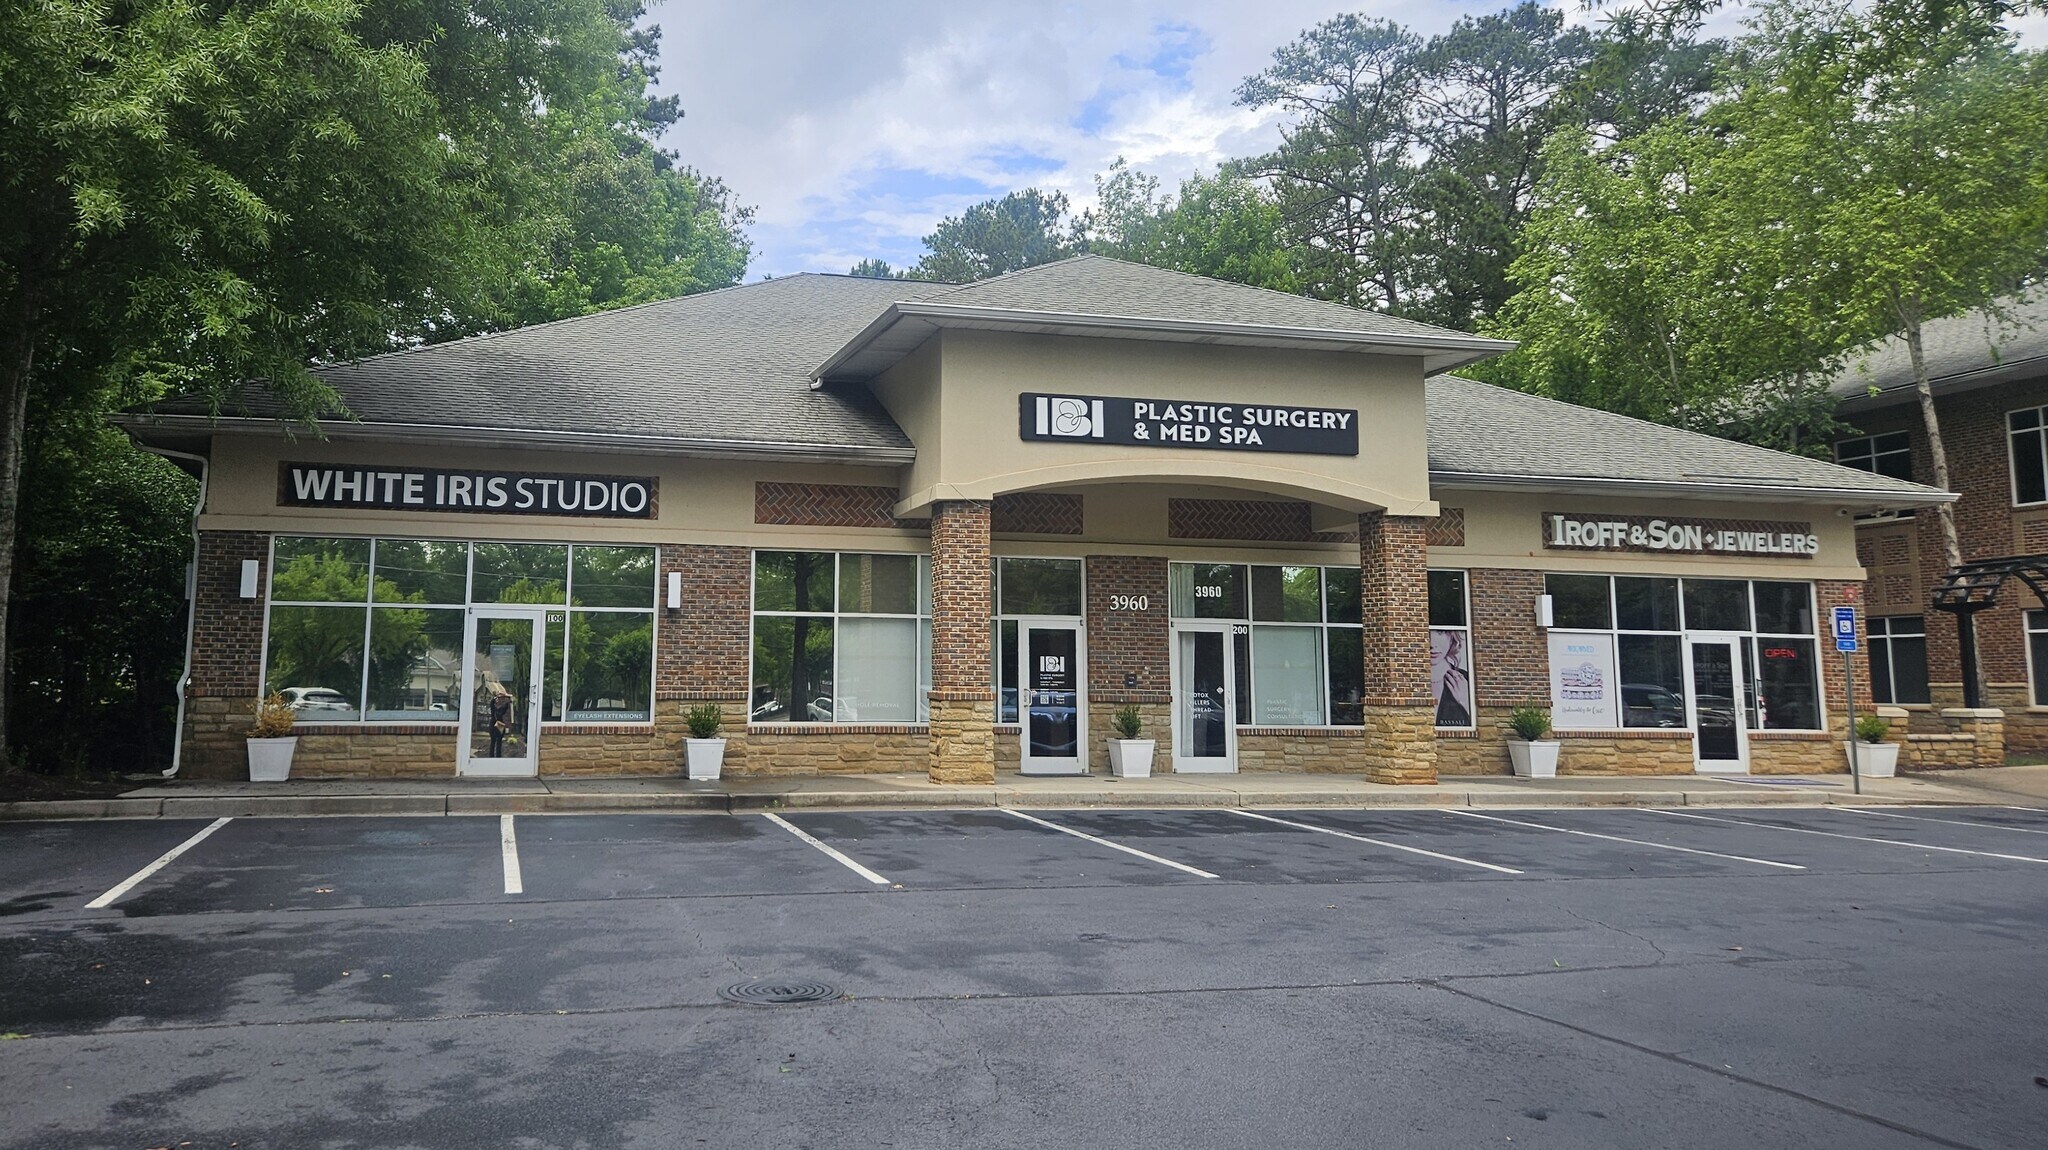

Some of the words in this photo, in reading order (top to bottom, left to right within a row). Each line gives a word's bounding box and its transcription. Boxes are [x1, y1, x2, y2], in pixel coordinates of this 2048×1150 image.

[1134, 402, 1233, 424] PLASTIC
[1242, 407, 1352, 430] SURGERY
[1133, 422, 1151, 440] &
[1160, 423, 1212, 443] MED
[1218, 426, 1263, 445] SPA
[292, 468, 425, 504] WHITE
[435, 474, 507, 508] IRIS
[514, 478, 648, 513] STUDIO
[1713, 529, 1819, 555] JEWELERS
[1194, 585, 1222, 598] 3960
[1109, 594, 1148, 611] 3960
[548, 614, 564, 622] 100
[1232, 625, 1248, 635] 200
[1764, 648, 1796, 658] OPEN
